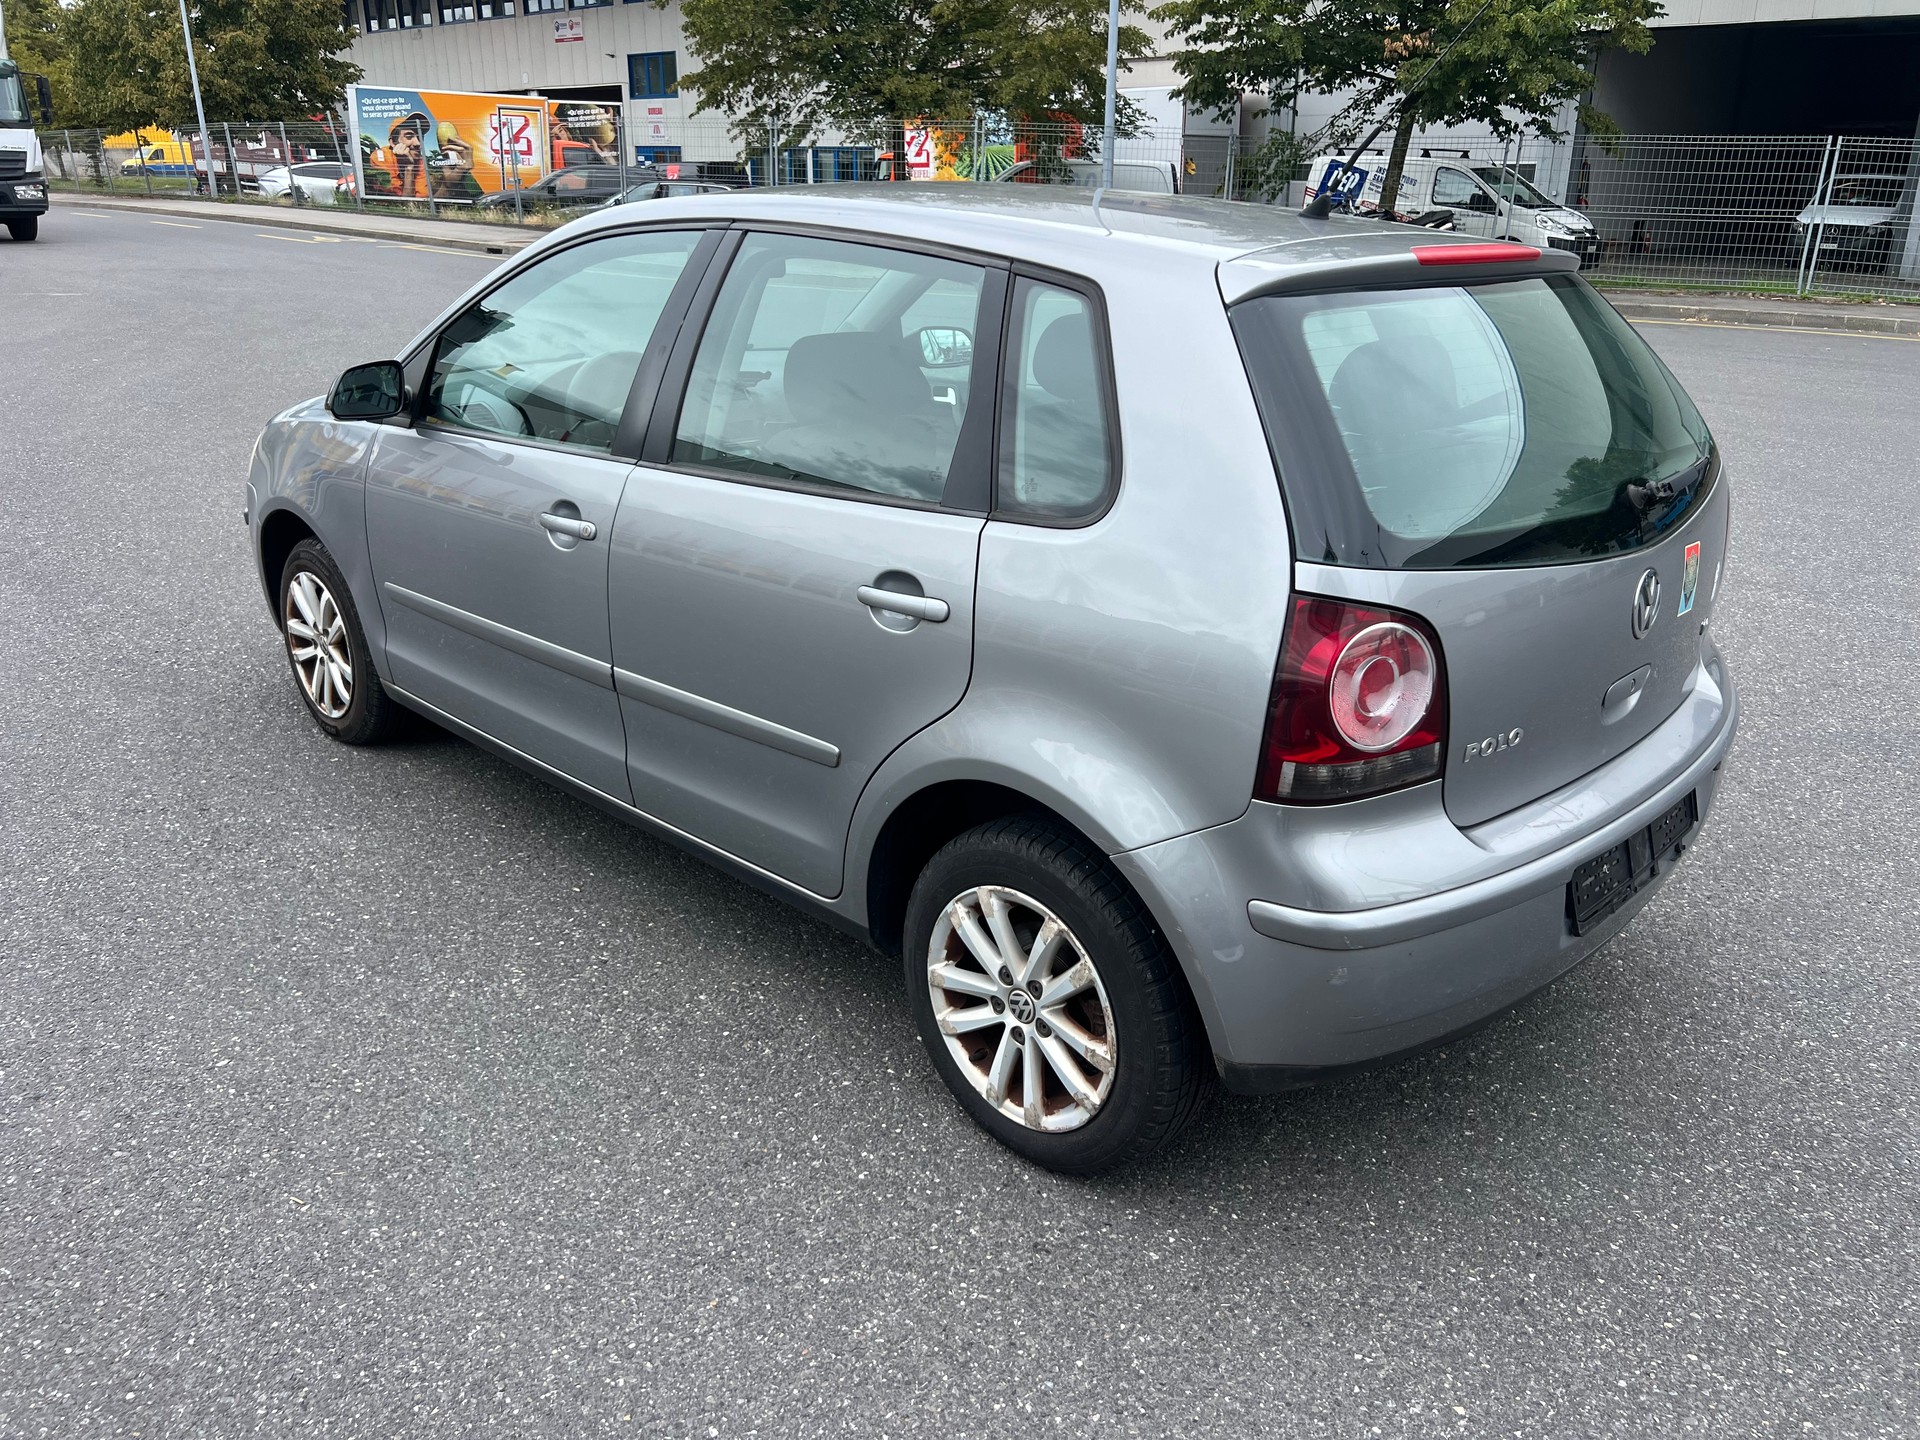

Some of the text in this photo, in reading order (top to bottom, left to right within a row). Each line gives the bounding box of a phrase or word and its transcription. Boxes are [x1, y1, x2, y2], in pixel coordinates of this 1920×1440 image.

[388, 97, 399, 105] que
[383, 111, 401, 119] grande
[1463, 727, 1525, 763] POLO
